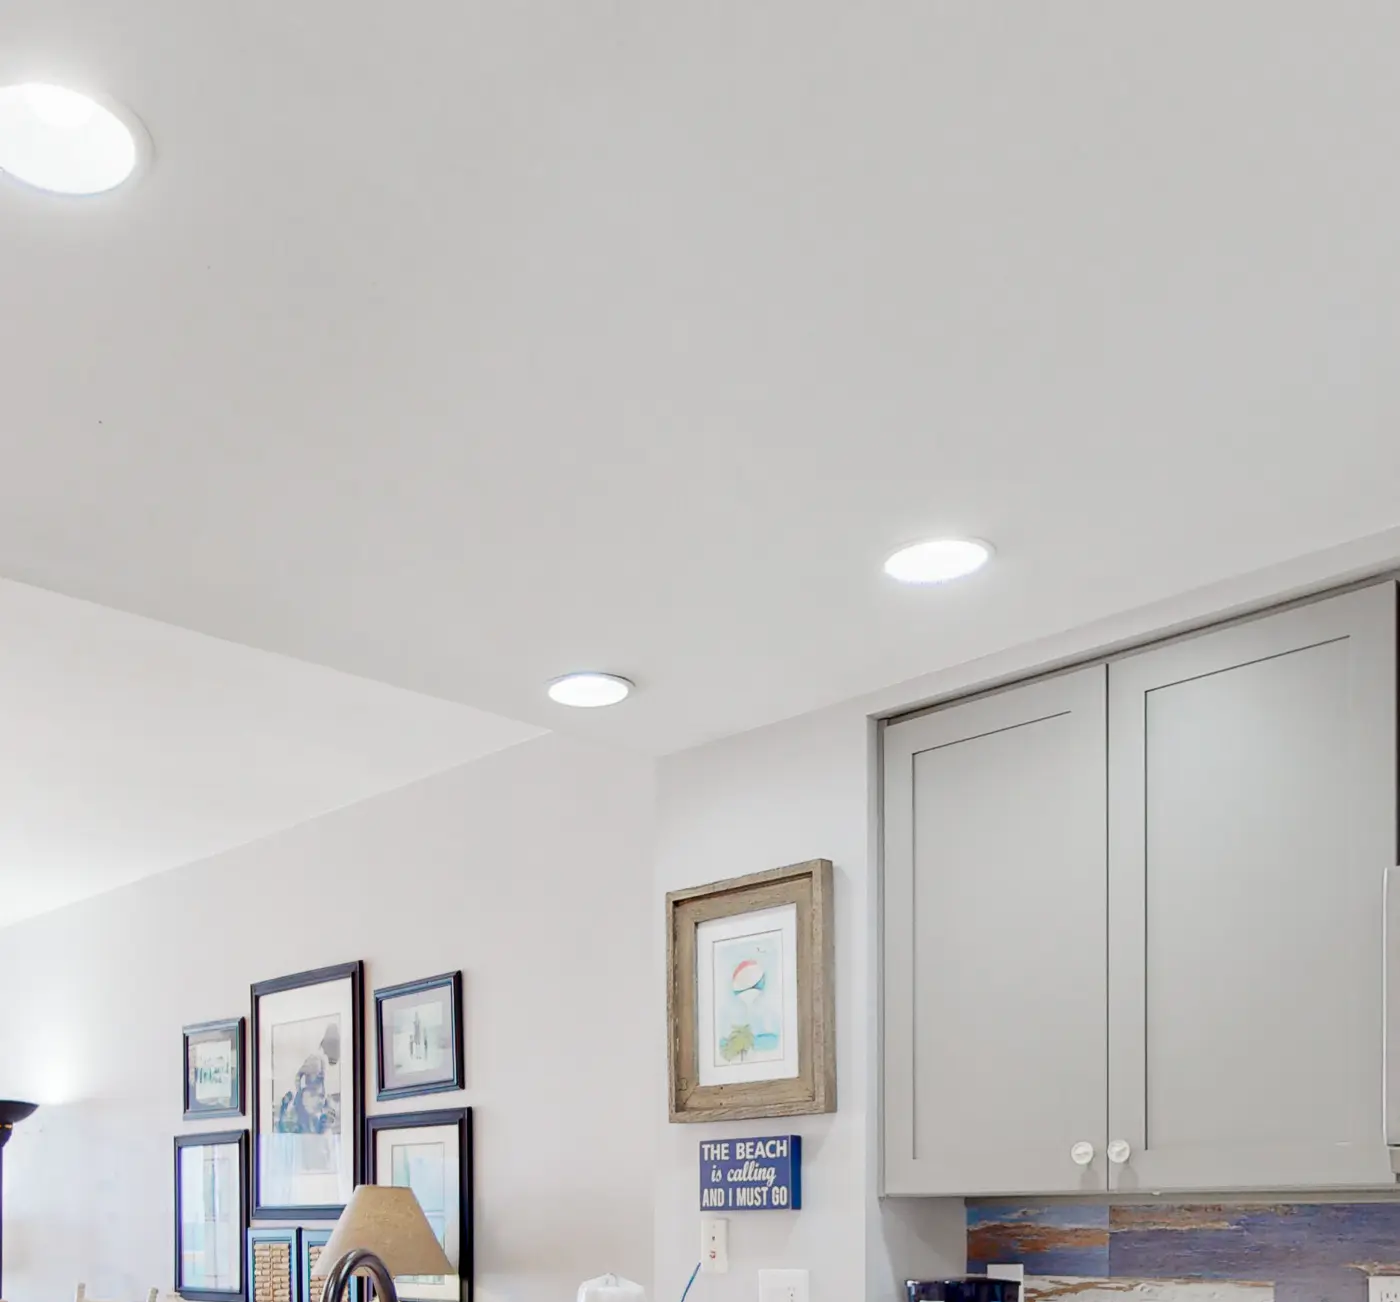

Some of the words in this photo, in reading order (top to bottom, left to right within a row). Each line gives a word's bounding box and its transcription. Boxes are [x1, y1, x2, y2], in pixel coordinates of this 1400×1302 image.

[702, 1143, 730, 1161] THE
[735, 1140, 788, 1160] BEACH
[711, 1164, 723, 1183] is
[727, 1160, 776, 1187] calling
[702, 1188, 725, 1207] AND
[728, 1187, 733, 1207] I
[736, 1186, 769, 1206] MUST
[771, 1186, 788, 1206] GO
